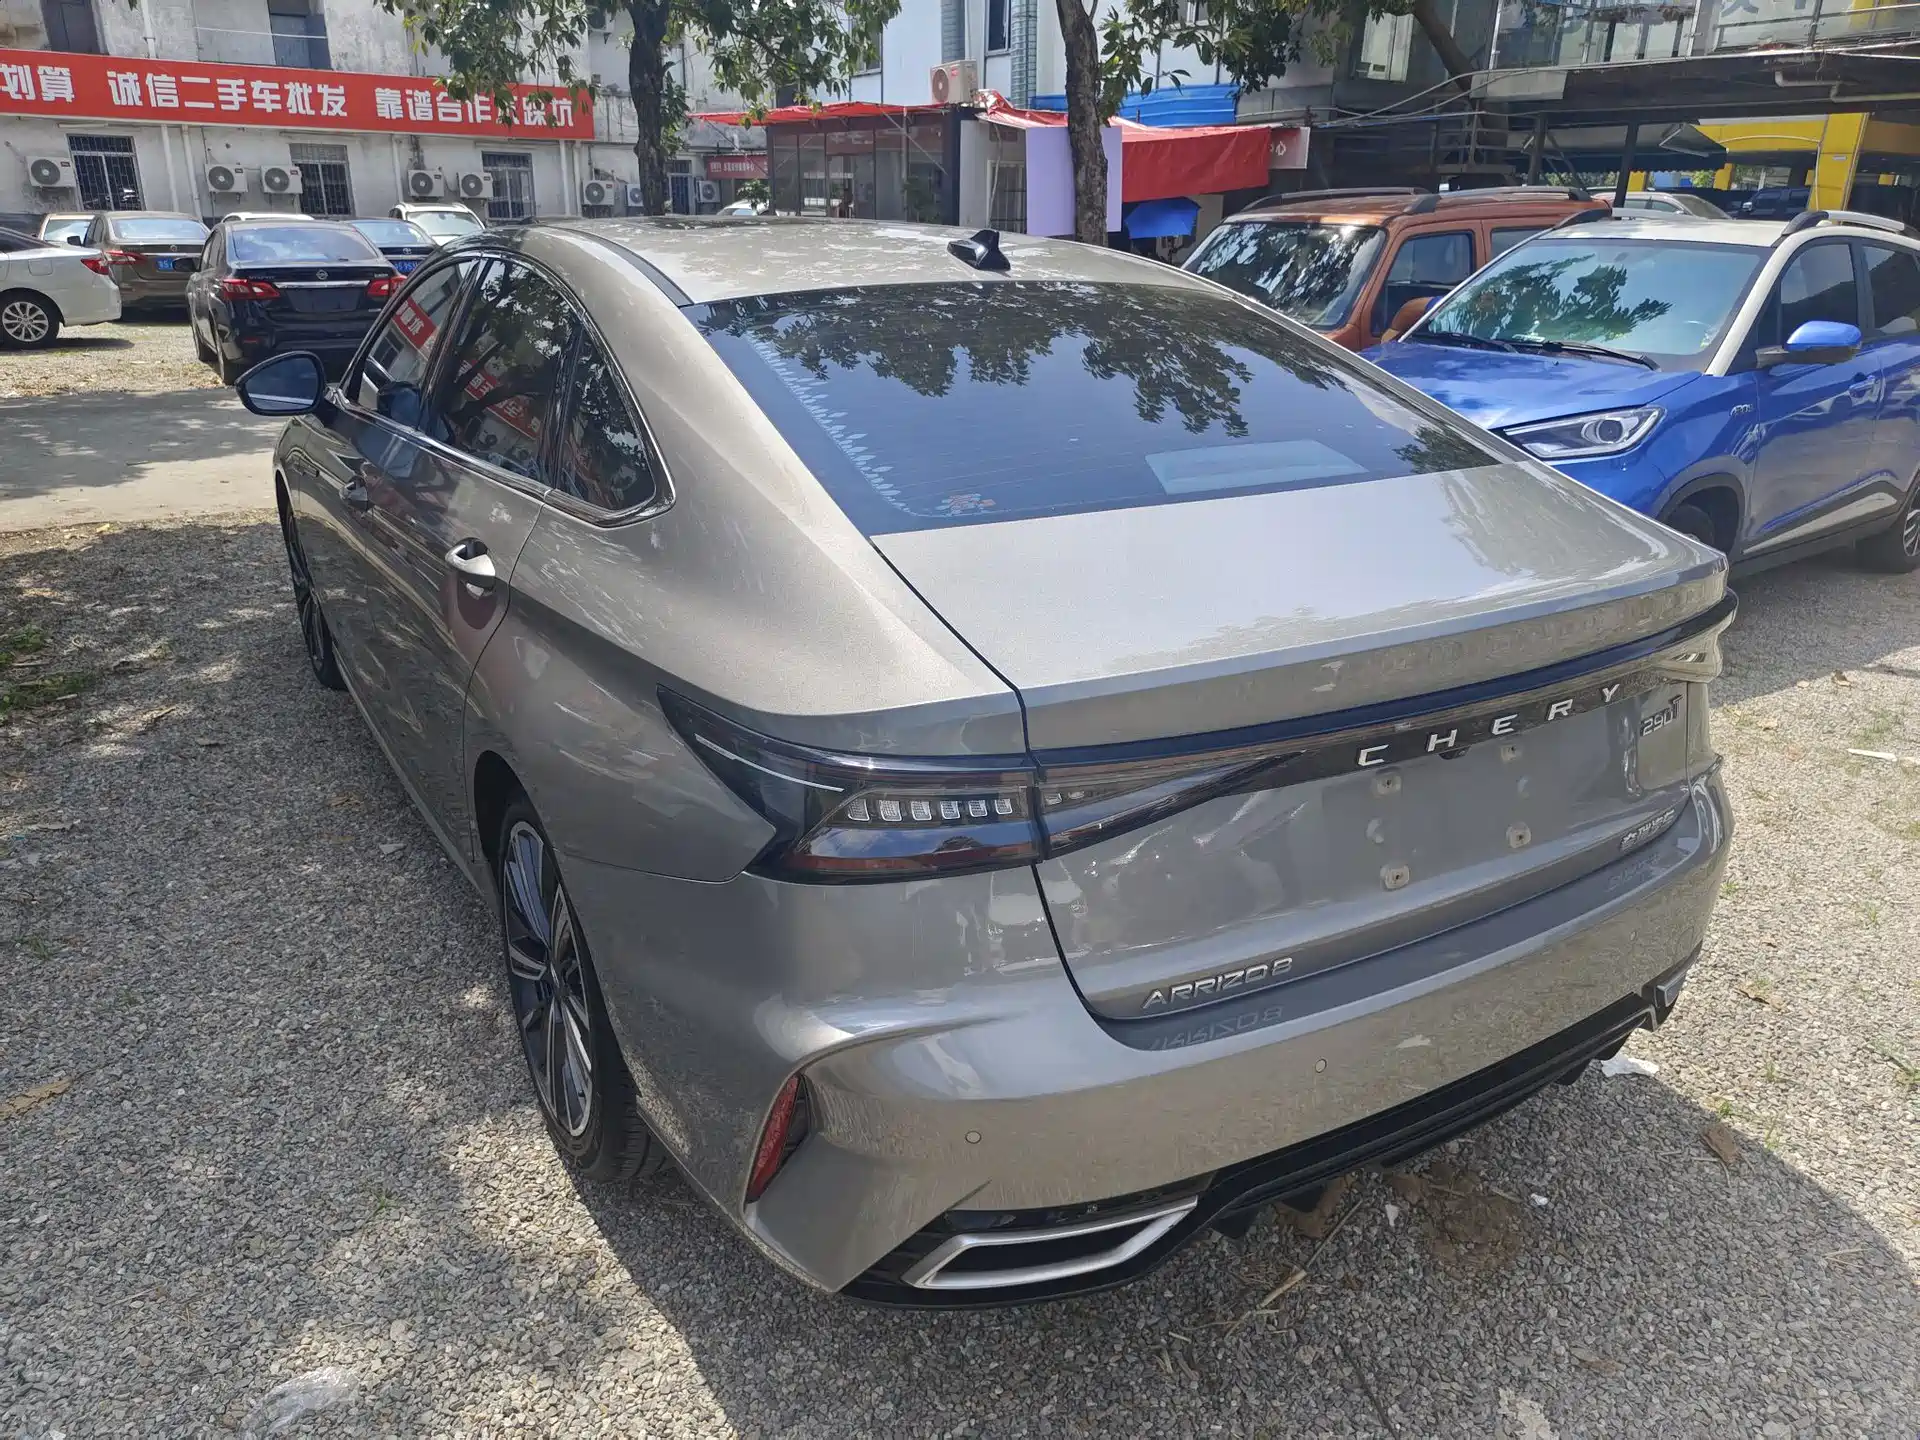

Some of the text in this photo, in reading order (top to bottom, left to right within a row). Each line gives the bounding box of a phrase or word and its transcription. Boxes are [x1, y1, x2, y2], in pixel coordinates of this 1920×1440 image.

[0, 63, 75, 103] 划算
[106, 70, 348, 118] 诚信二手车批发
[1357, 683, 1621, 767] CHERY
[1640, 694, 1684, 736] 290T
